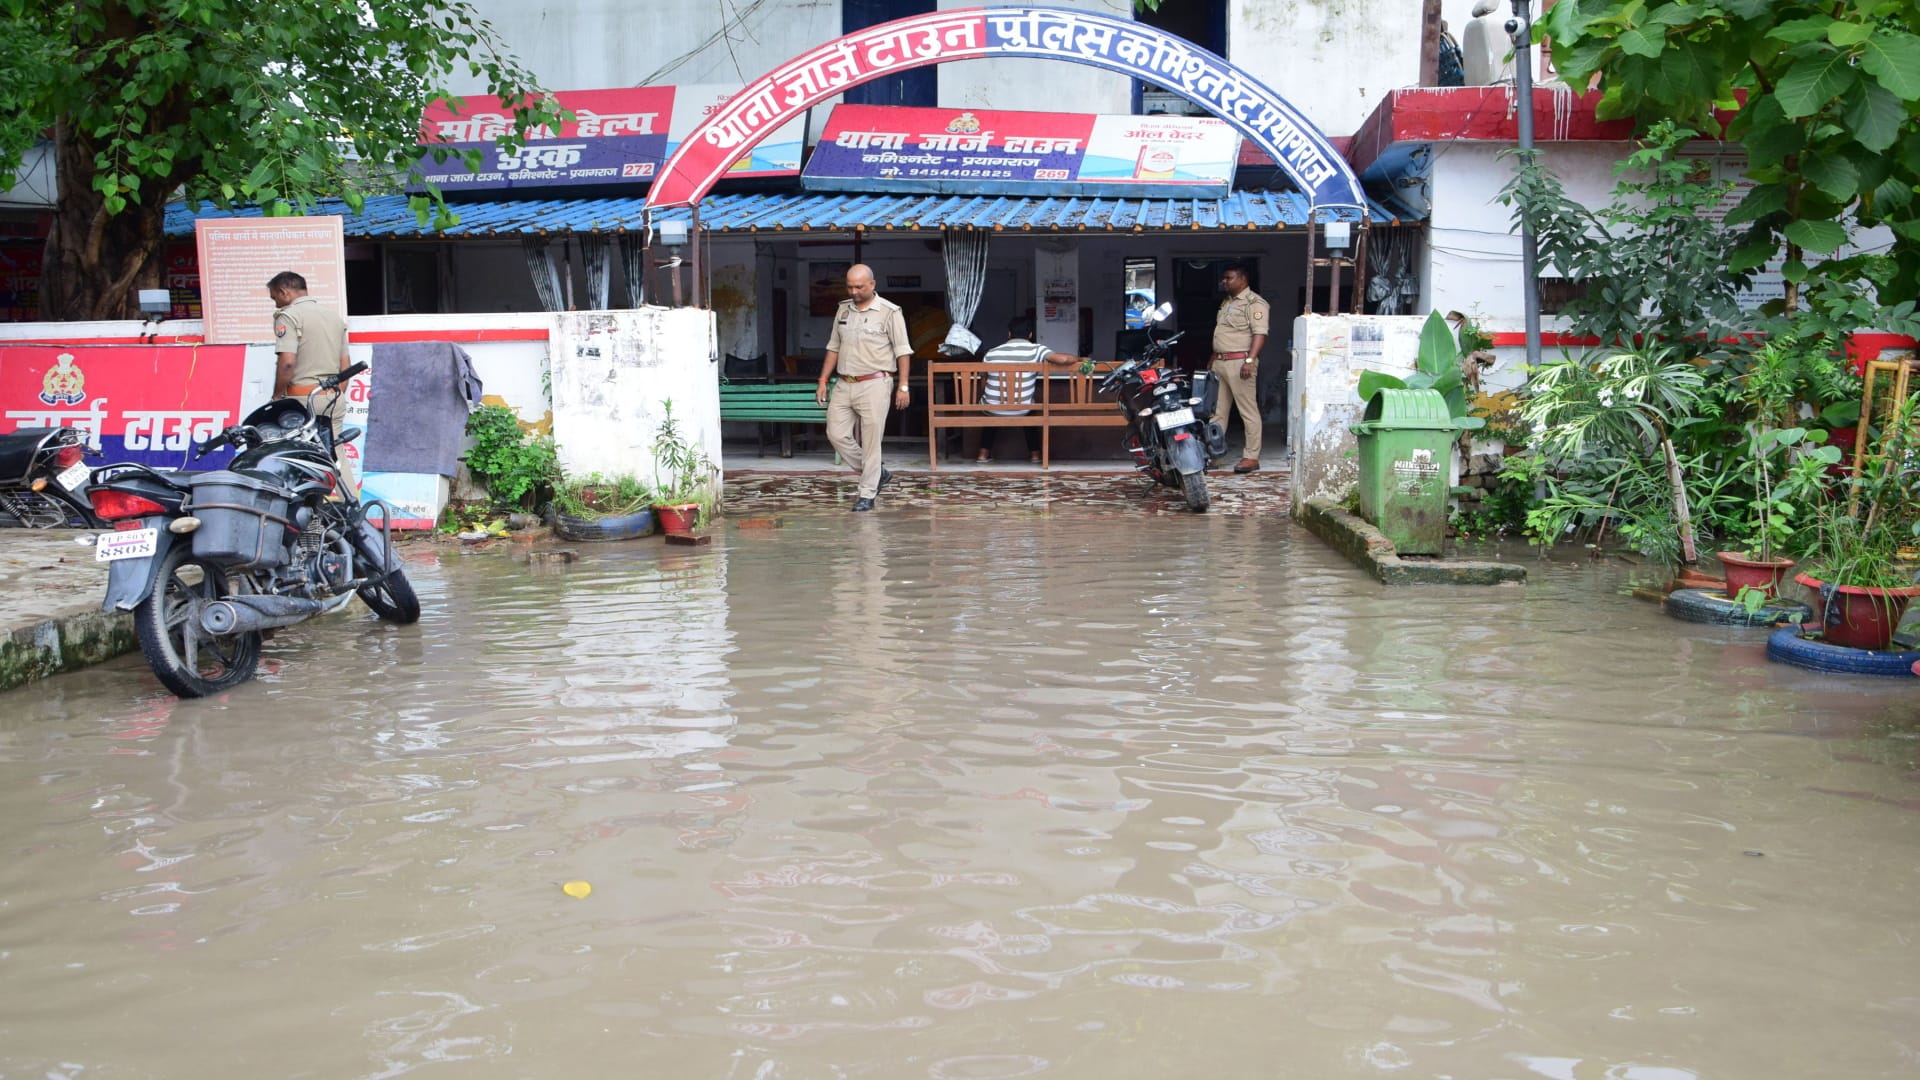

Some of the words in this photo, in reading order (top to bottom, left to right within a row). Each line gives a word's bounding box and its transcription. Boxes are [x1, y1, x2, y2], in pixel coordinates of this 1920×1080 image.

[705, 84, 782, 148] थाना
[774, 42, 860, 107] जार्ज
[866, 18, 982, 66] टाउन
[987, 12, 1117, 59] पुलिस
[1115, 29, 1264, 120] कमिश्नरेट
[1250, 102, 1337, 189] प्रयागराज
[575, 109, 659, 137] हेल्प
[836, 131, 911, 150] थाना
[918, 130, 995, 152] जार्ज
[1003, 136, 1083, 155] टाउन
[862, 151, 944, 164] कमिश्नरेट
[962, 156, 1041, 167] प्रयागराज
[569, 167, 619, 179] प्रयागराज
[624, 164, 653, 176] 272
[909, 168, 1012, 177] 9454402825
[1036, 170, 1067, 178] 269
[122, 411, 231, 451] टाउन
